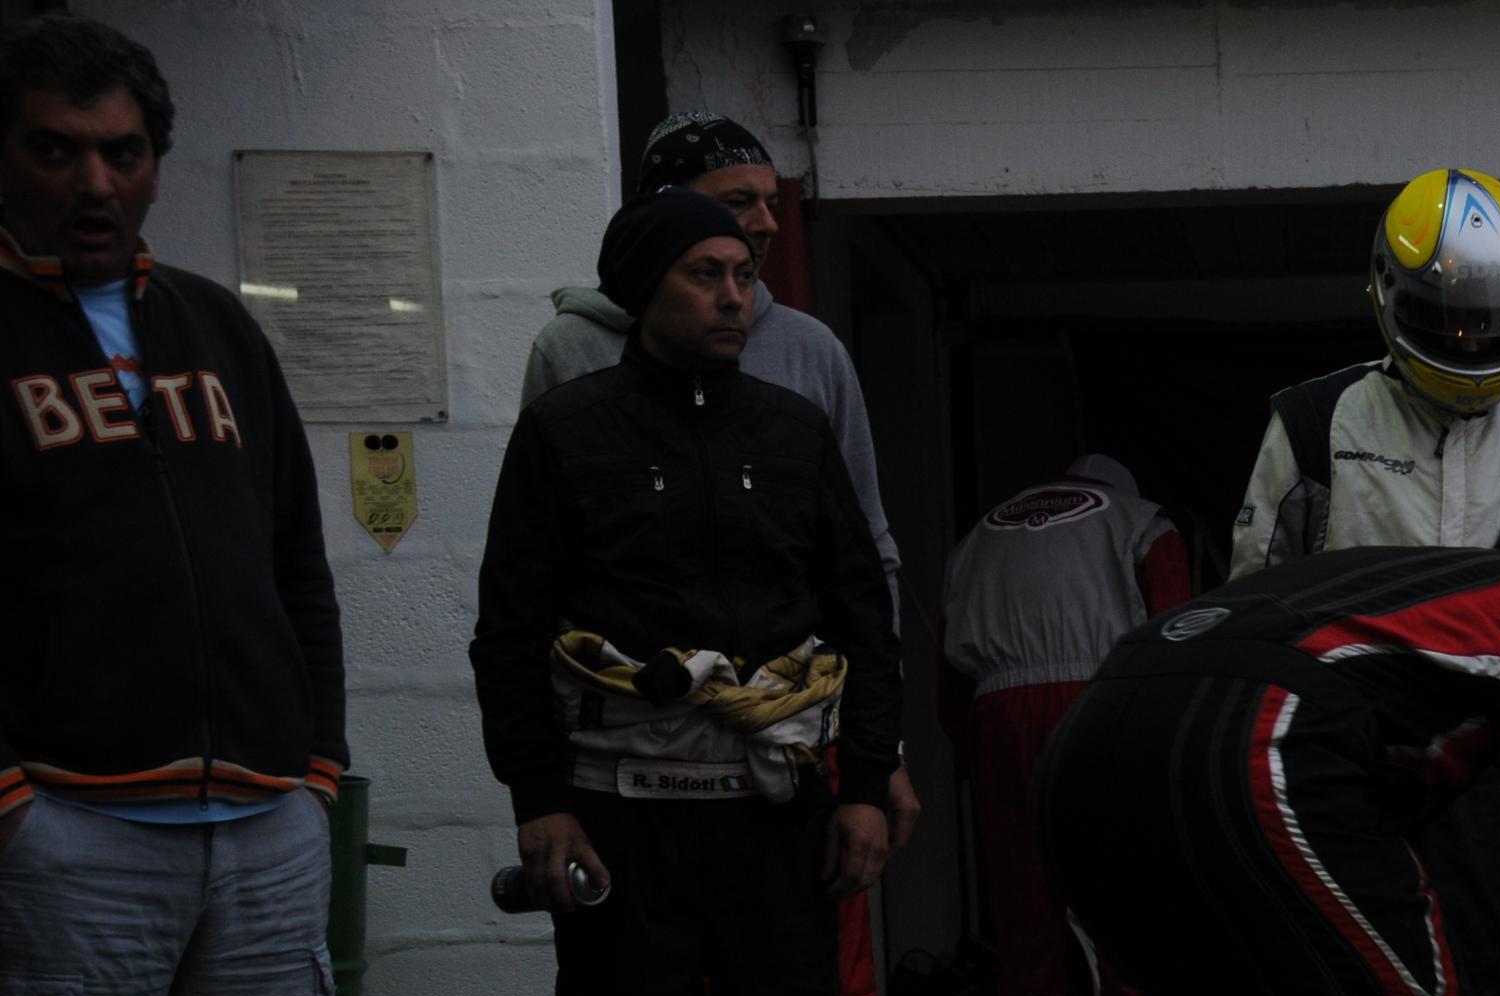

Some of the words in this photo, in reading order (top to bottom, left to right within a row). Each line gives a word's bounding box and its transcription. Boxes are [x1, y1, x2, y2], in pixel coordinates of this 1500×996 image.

[9, 367, 243, 452] BETA
[633, 773, 652, 788] R.
[659, 774, 715, 791] Sidoti
